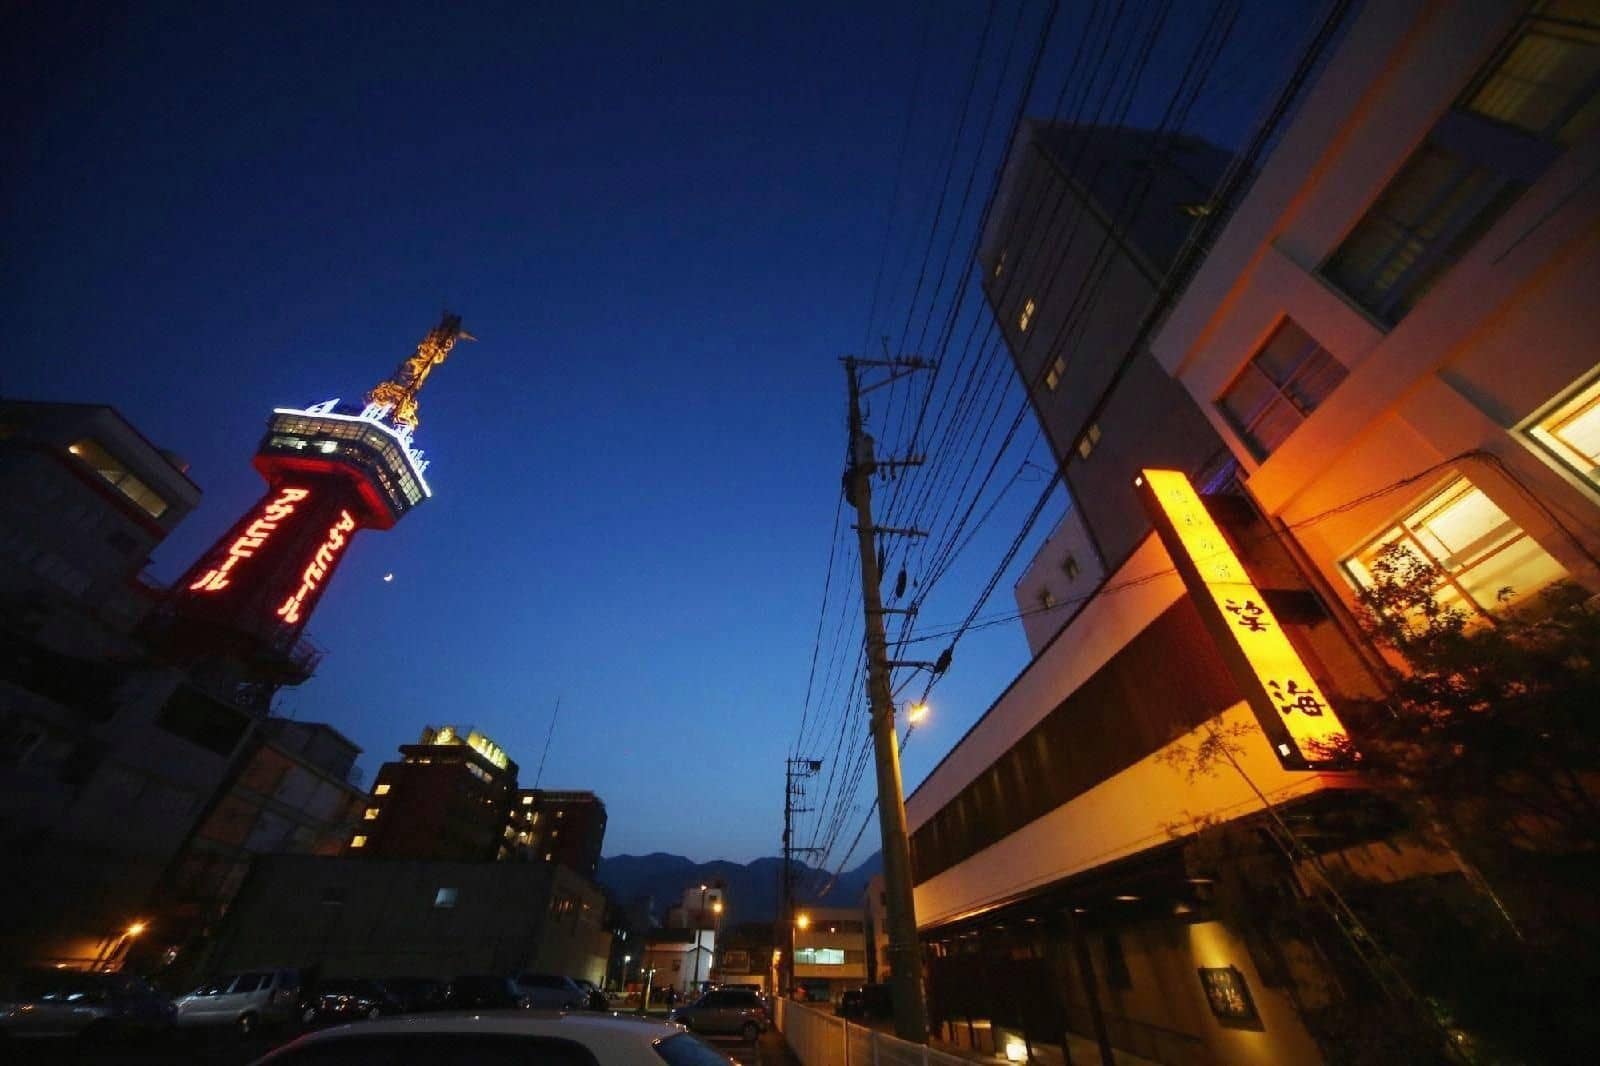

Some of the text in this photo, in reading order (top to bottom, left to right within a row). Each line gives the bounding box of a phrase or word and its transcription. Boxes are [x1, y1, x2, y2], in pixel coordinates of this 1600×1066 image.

[190, 488, 309, 590] アサヒビール
[278, 510, 355, 623] アサヒビール
